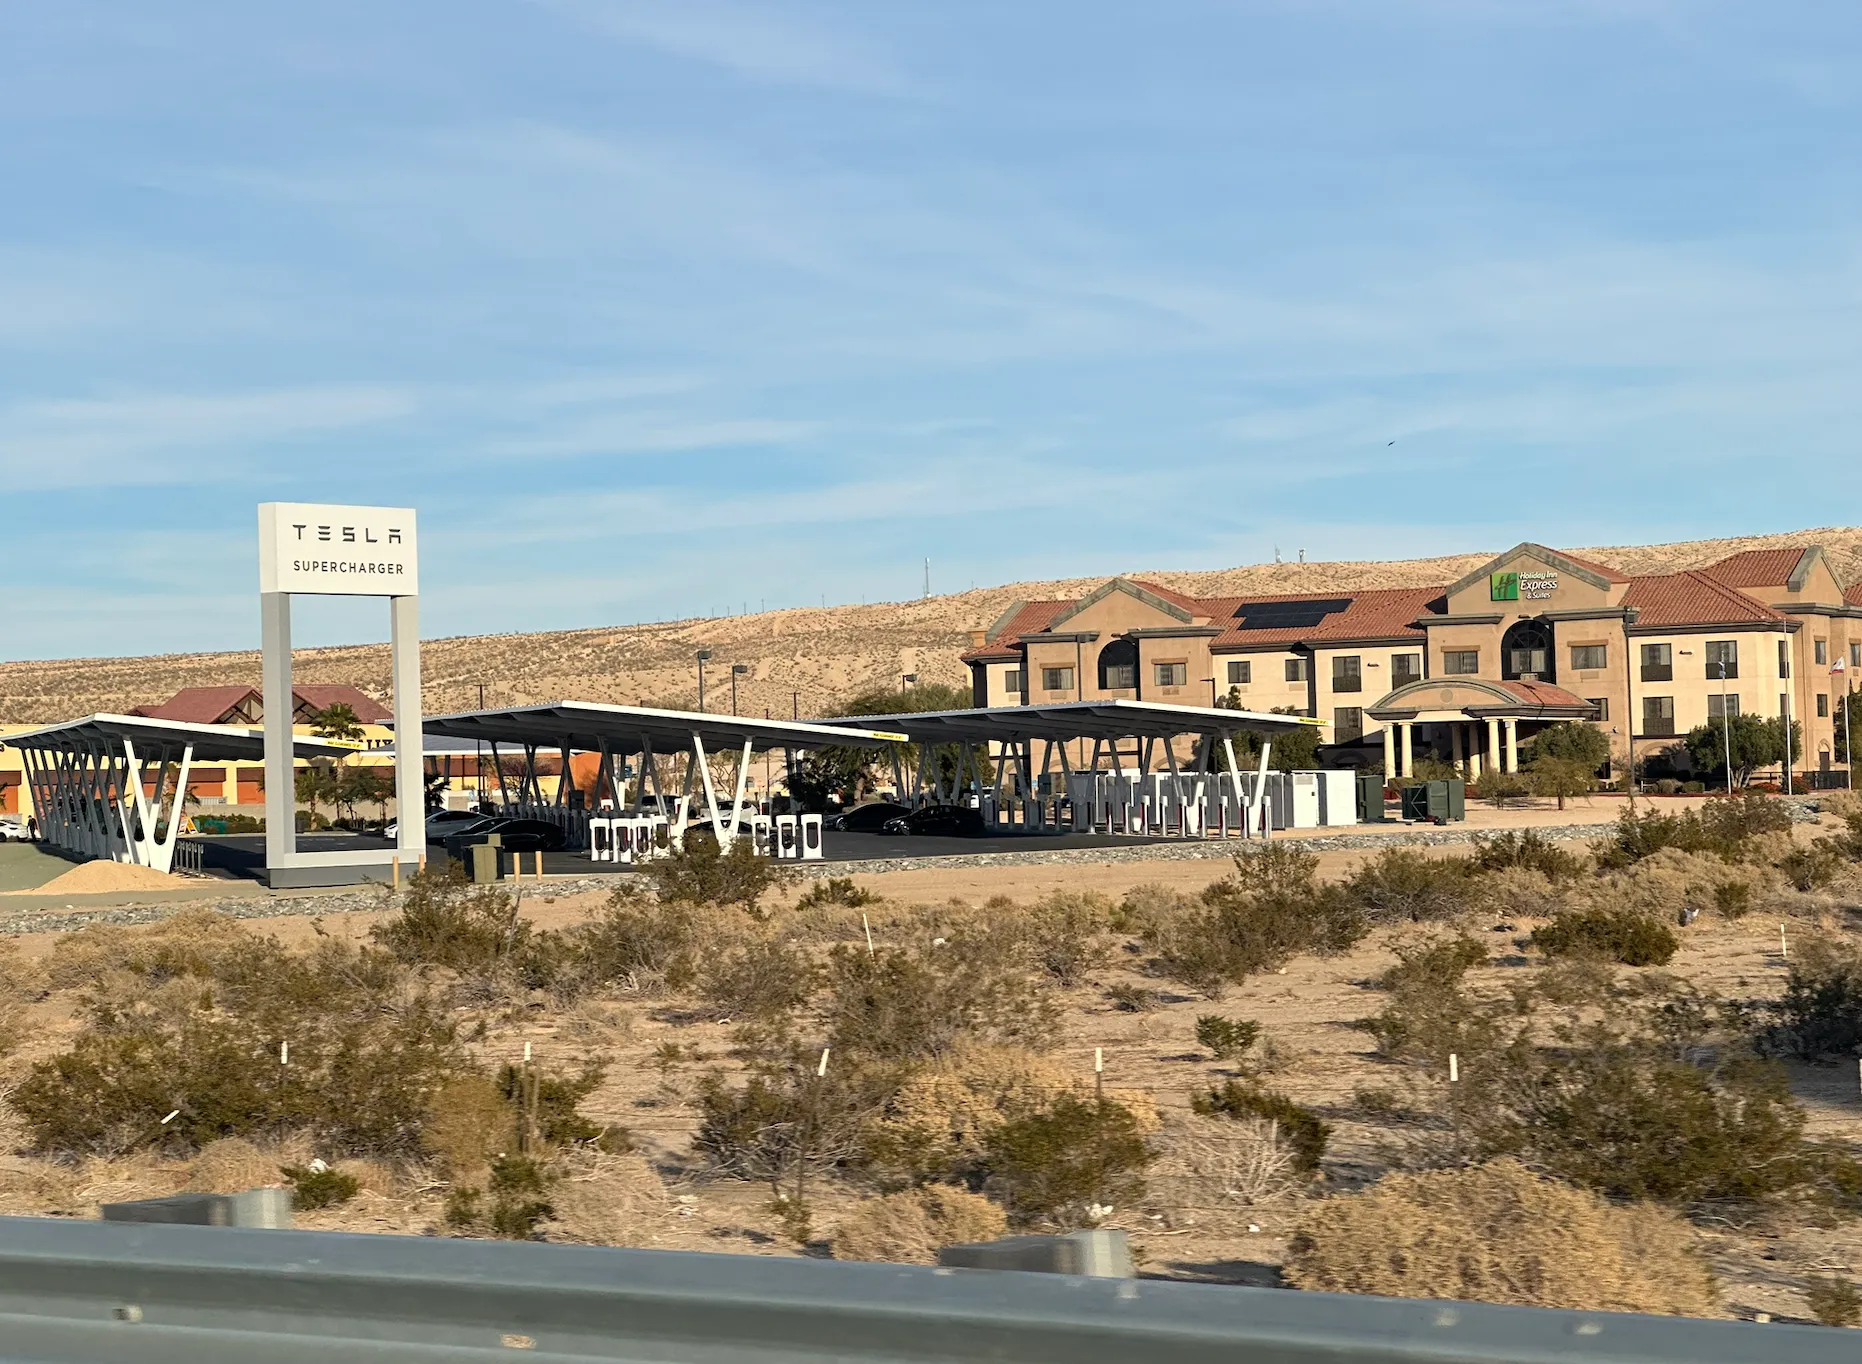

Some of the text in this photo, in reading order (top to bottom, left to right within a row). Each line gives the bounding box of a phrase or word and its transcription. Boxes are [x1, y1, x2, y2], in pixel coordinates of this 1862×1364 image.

[292, 524, 402, 544] TESLA
[293, 560, 404, 575] SUPERCHARGER
[1519, 570, 1558, 580] Holiday Inn
[1520, 580, 1558, 592] Express
[1532, 591, 1551, 599] Suites
